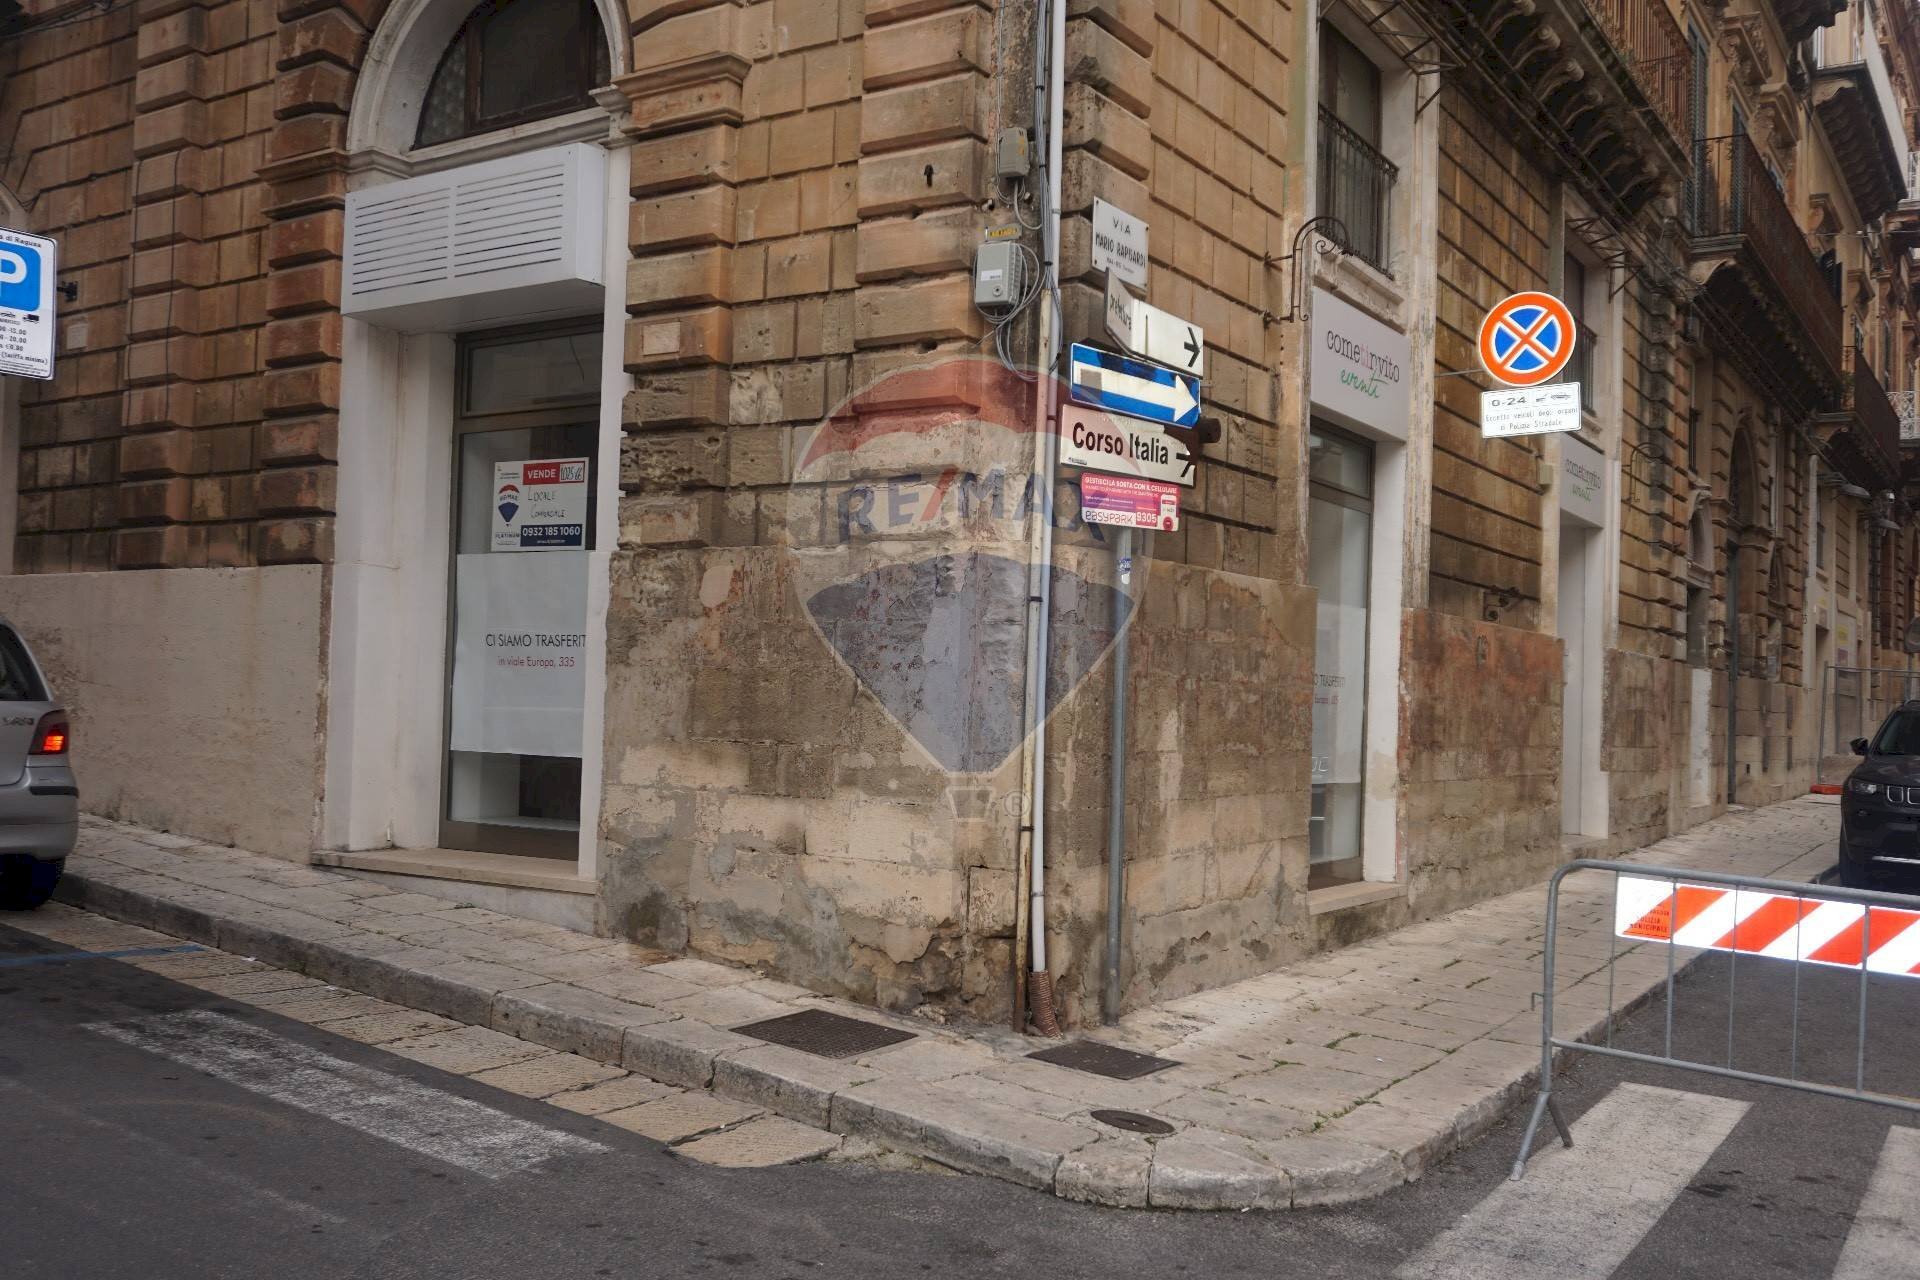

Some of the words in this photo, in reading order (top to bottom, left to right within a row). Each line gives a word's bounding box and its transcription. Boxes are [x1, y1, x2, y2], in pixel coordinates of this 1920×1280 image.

[1113, 215, 1131, 235] VIA
[15, 236, 42, 248] Ragusa
[1095, 231, 1115, 253] MARIO
[1072, 421, 1124, 456] Corso
[1129, 432, 1169, 465] Italia
[527, 468, 557, 479] VENDE
[1116, 480, 1133, 489] SOSTA
[1136, 511, 1157, 523] 9305
[522, 527, 543, 536] 0932
[545, 526, 558, 536] 185
[560, 526, 581, 536] 1060
[486, 634, 496, 647] CI
[498, 634, 532, 647] SIAMO
[498, 656, 506, 666] in
[507, 656, 525, 666] viale
[527, 656, 556, 669] Europa,
[559, 656, 575, 667] 335
